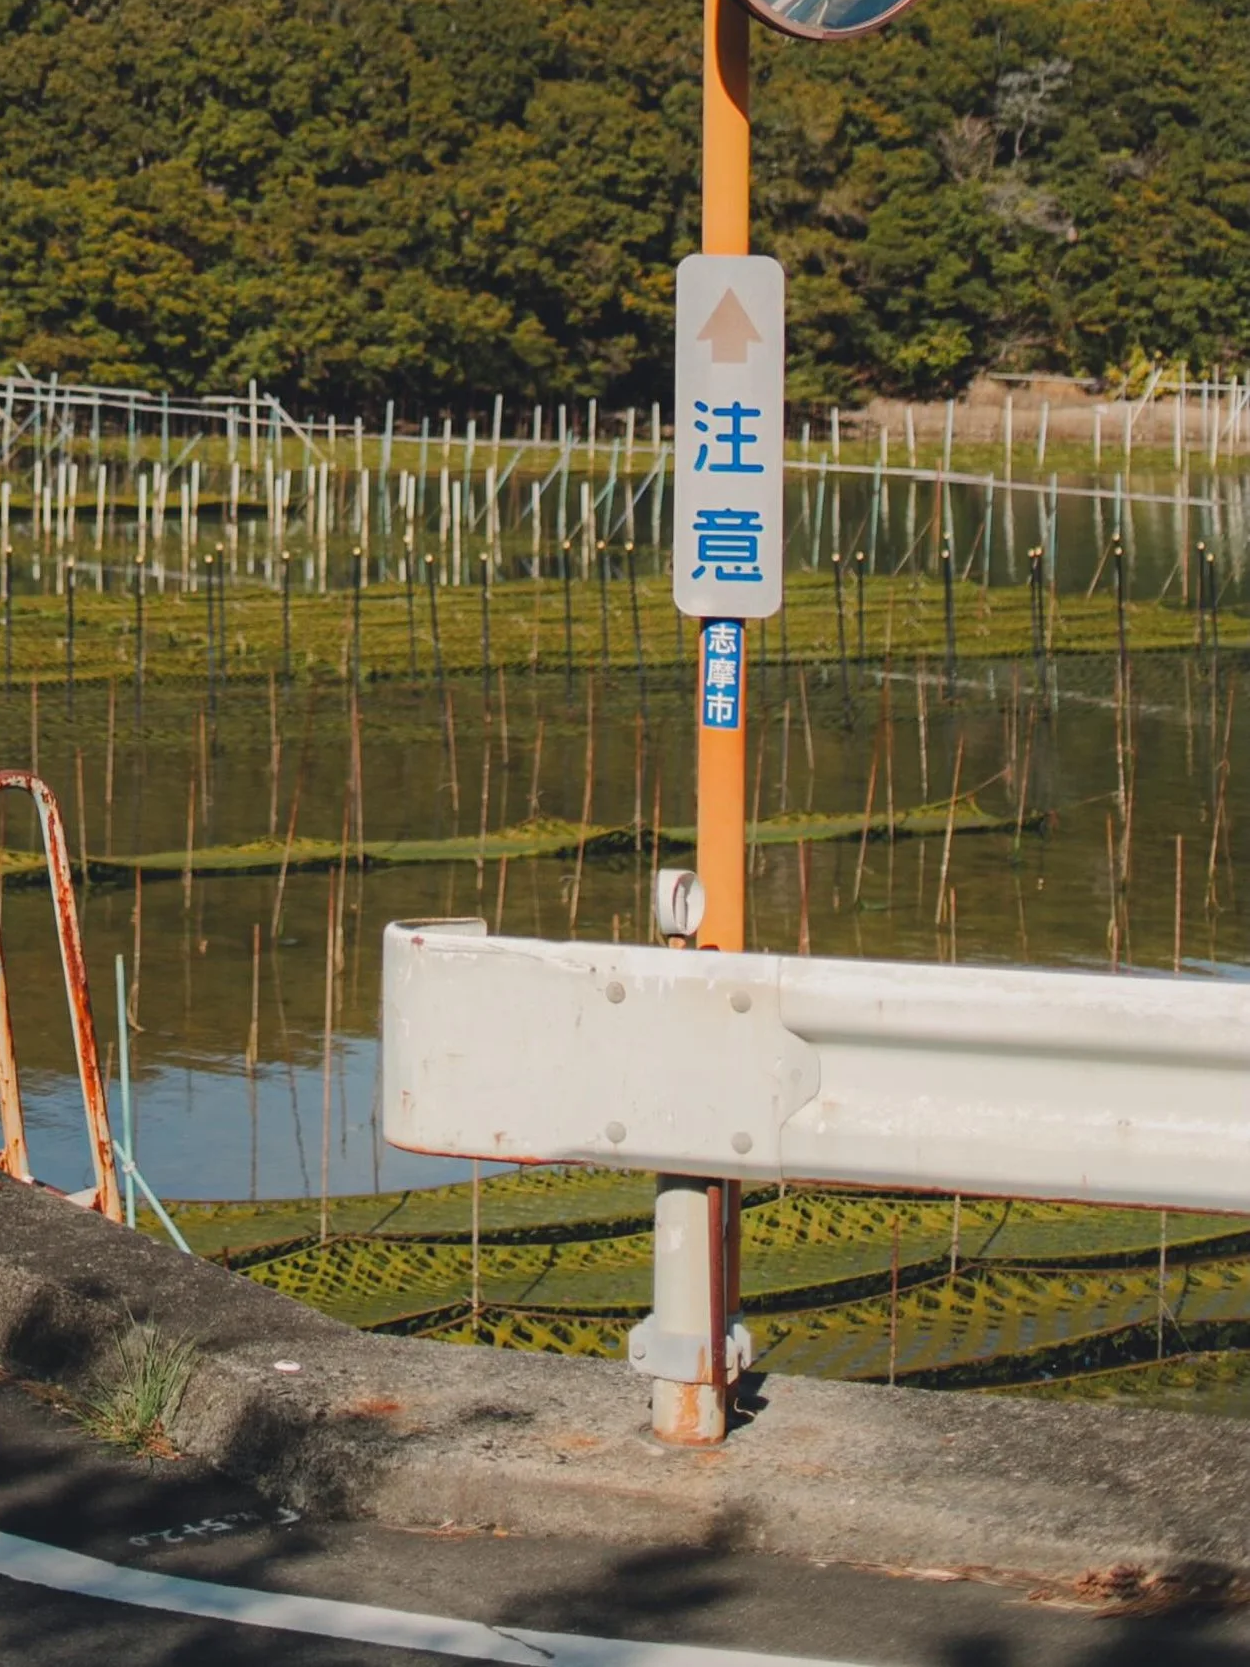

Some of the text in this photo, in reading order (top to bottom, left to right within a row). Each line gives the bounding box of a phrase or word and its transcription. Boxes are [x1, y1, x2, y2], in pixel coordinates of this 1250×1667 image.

[691, 400, 765, 582] 注意
[706, 623, 738, 724] 志摩市
